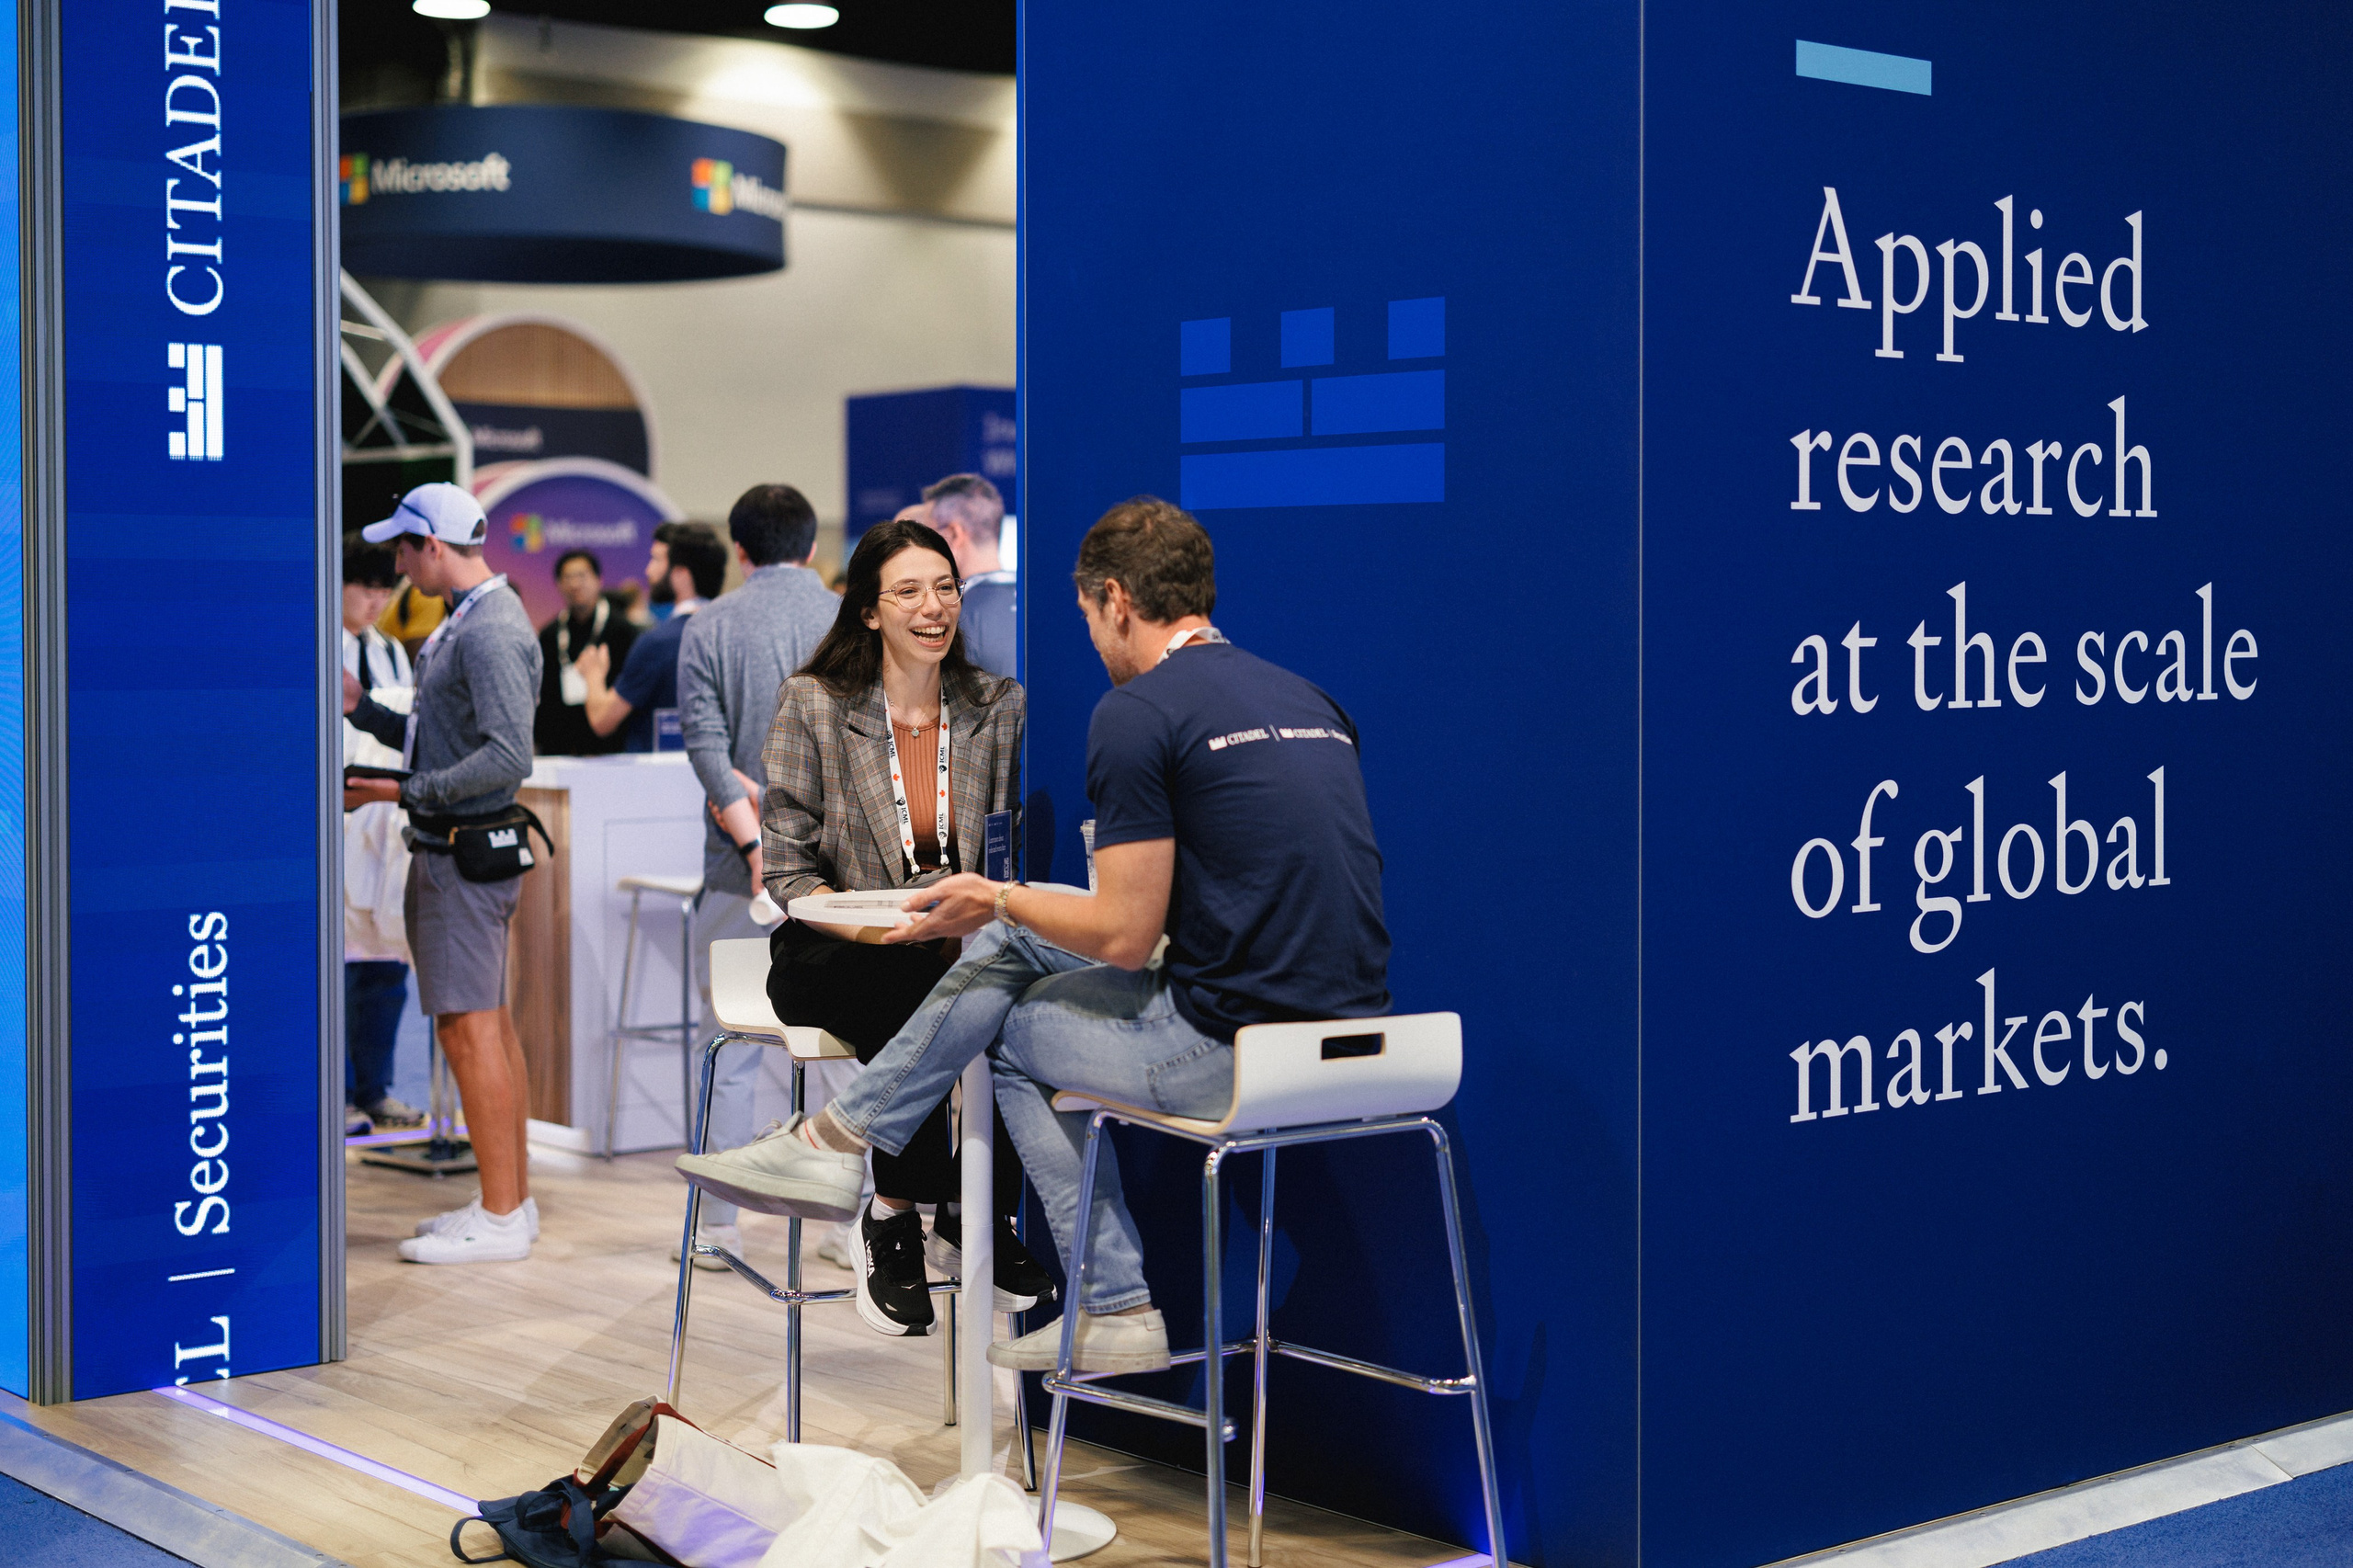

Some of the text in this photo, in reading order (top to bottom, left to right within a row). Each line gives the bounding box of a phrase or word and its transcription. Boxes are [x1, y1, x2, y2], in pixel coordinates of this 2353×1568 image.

[369, 152, 512, 195] Microsoft
[1790, 186, 2149, 363] Applied
[1790, 395, 2158, 517] research
[1790, 580, 2258, 716] at the scale
[1227, 728, 1269, 745] CITADEL
[901, 807, 909, 824] ICML
[1790, 765, 2171, 954] of global
[172, 911, 230, 1236] Securities
[1789, 967, 2168, 1123] markets.
